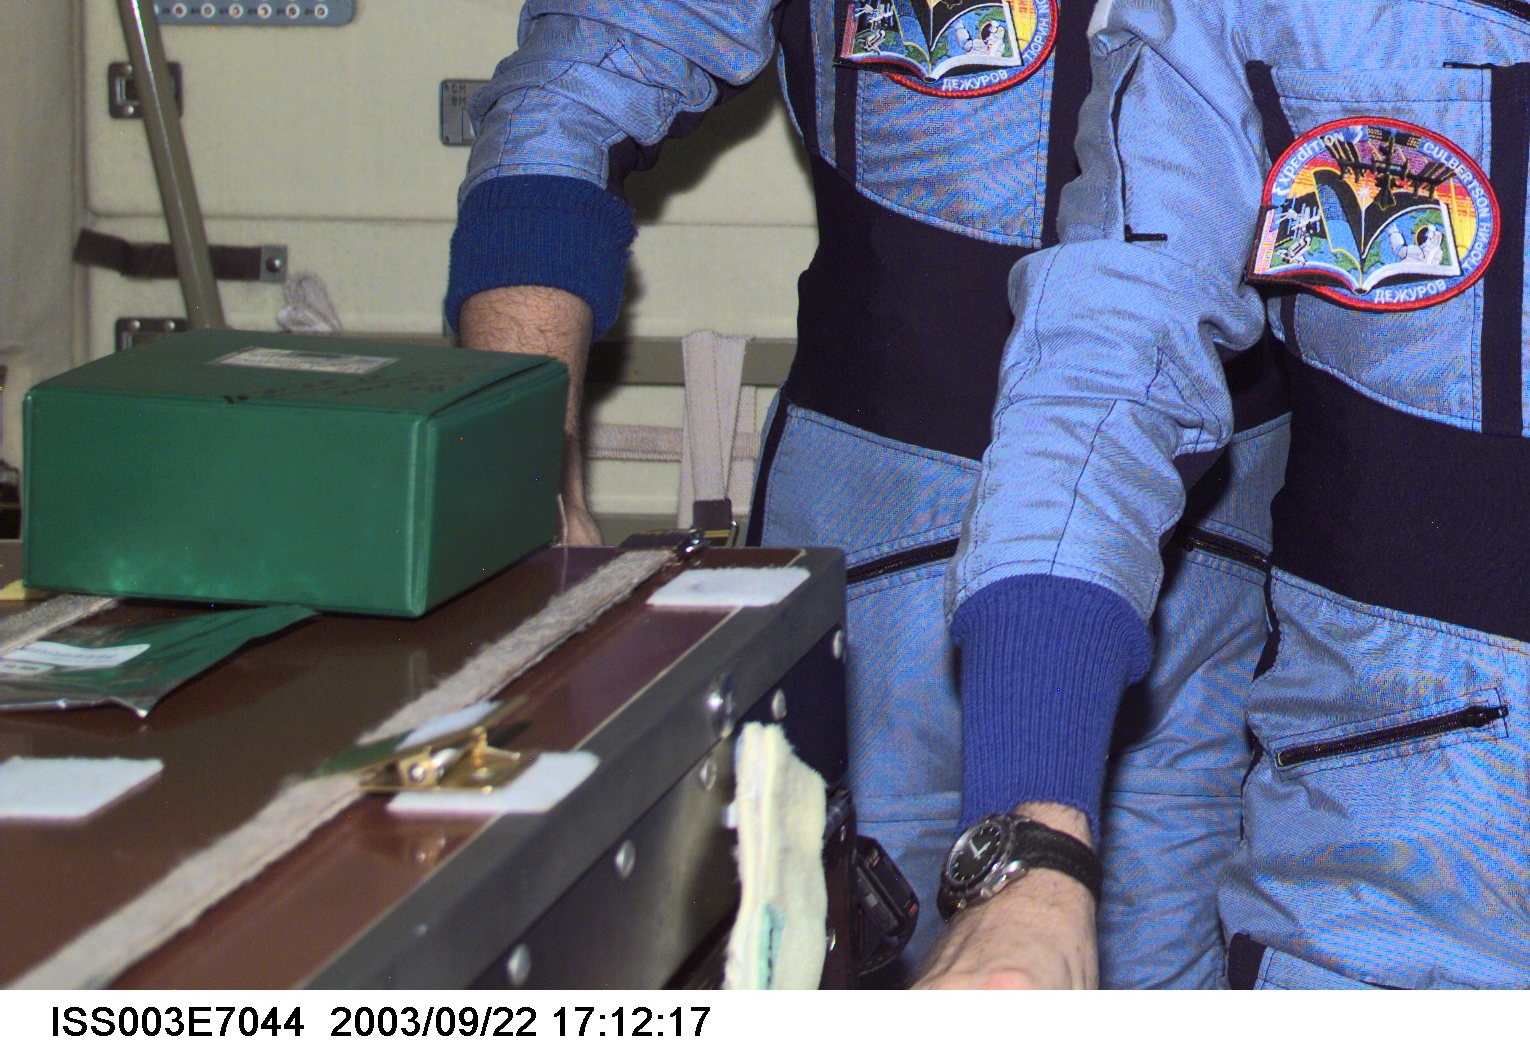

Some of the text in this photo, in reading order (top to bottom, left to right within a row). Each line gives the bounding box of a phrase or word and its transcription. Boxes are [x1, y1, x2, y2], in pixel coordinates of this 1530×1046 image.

[1022, 17, 1050, 61] ТЮРИН
[941, 69, 1009, 92] ДЕЖУРОВ
[1422, 141, 1491, 218] CULBERTSON
[1461, 221, 1491, 271] ТЮРИН
[1374, 280, 1447, 304] ДЕЖУРОВ
